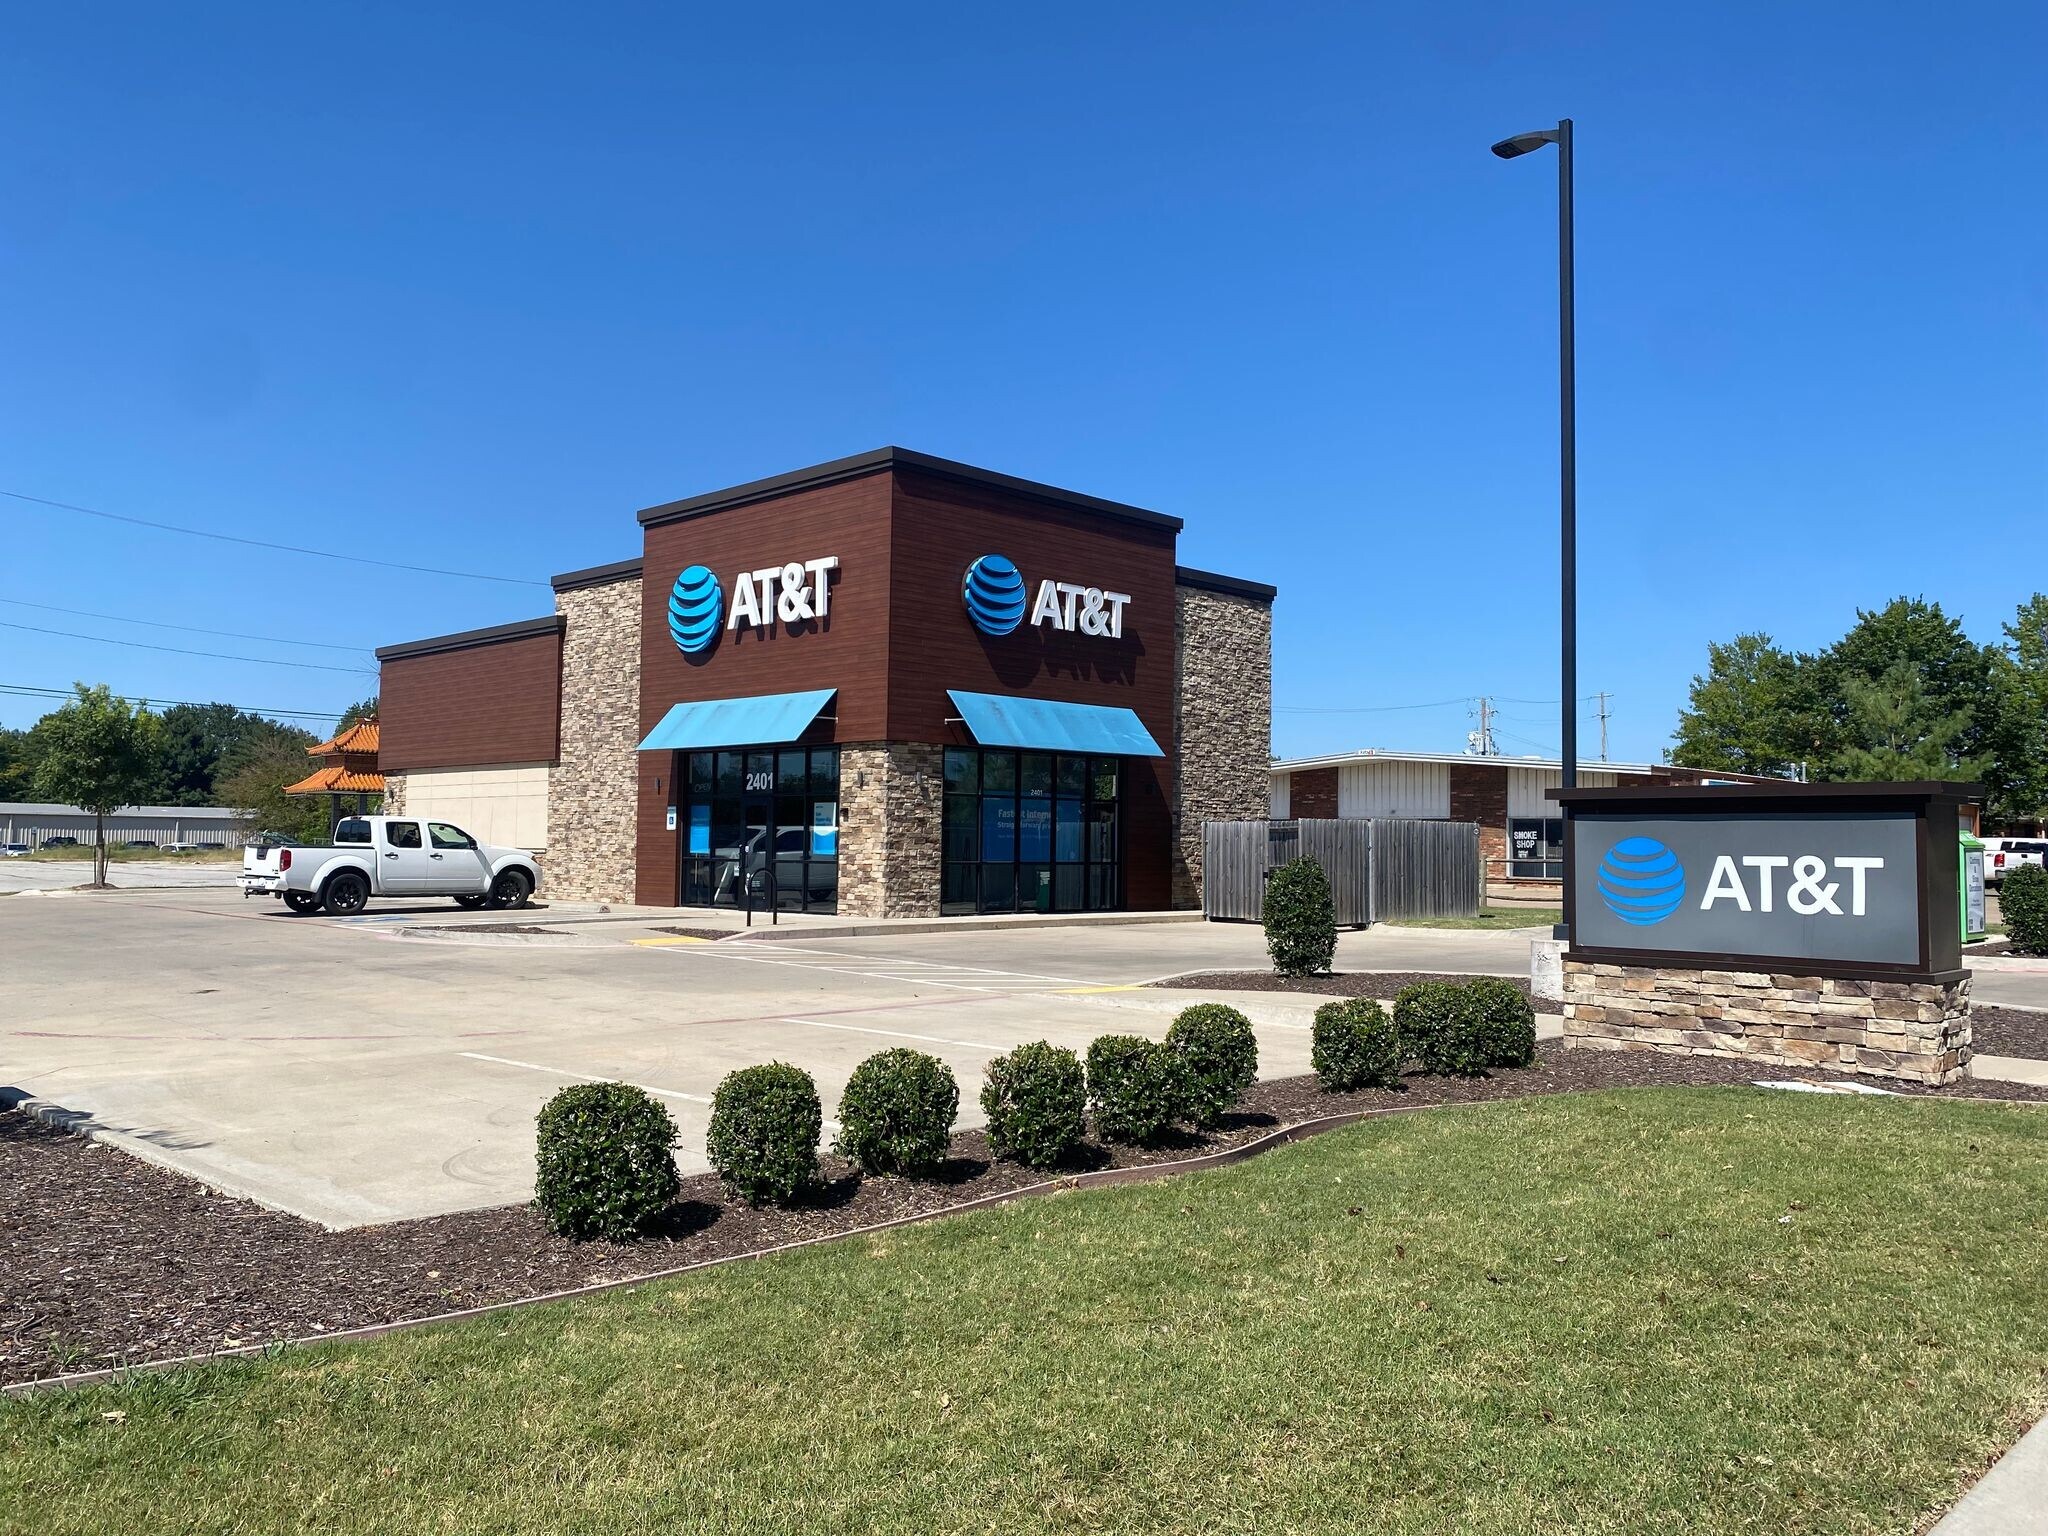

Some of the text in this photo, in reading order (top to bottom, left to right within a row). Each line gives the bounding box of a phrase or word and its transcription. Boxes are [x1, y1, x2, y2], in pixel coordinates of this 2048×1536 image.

[727, 556, 838, 630] AT&T
[1031, 579, 1132, 639] AT&T
[746, 772, 773, 791] 2401
[1514, 831, 1537, 839] SMOKE
[1516, 840, 1535, 848] SHOP
[1699, 855, 1885, 917] AT&T
